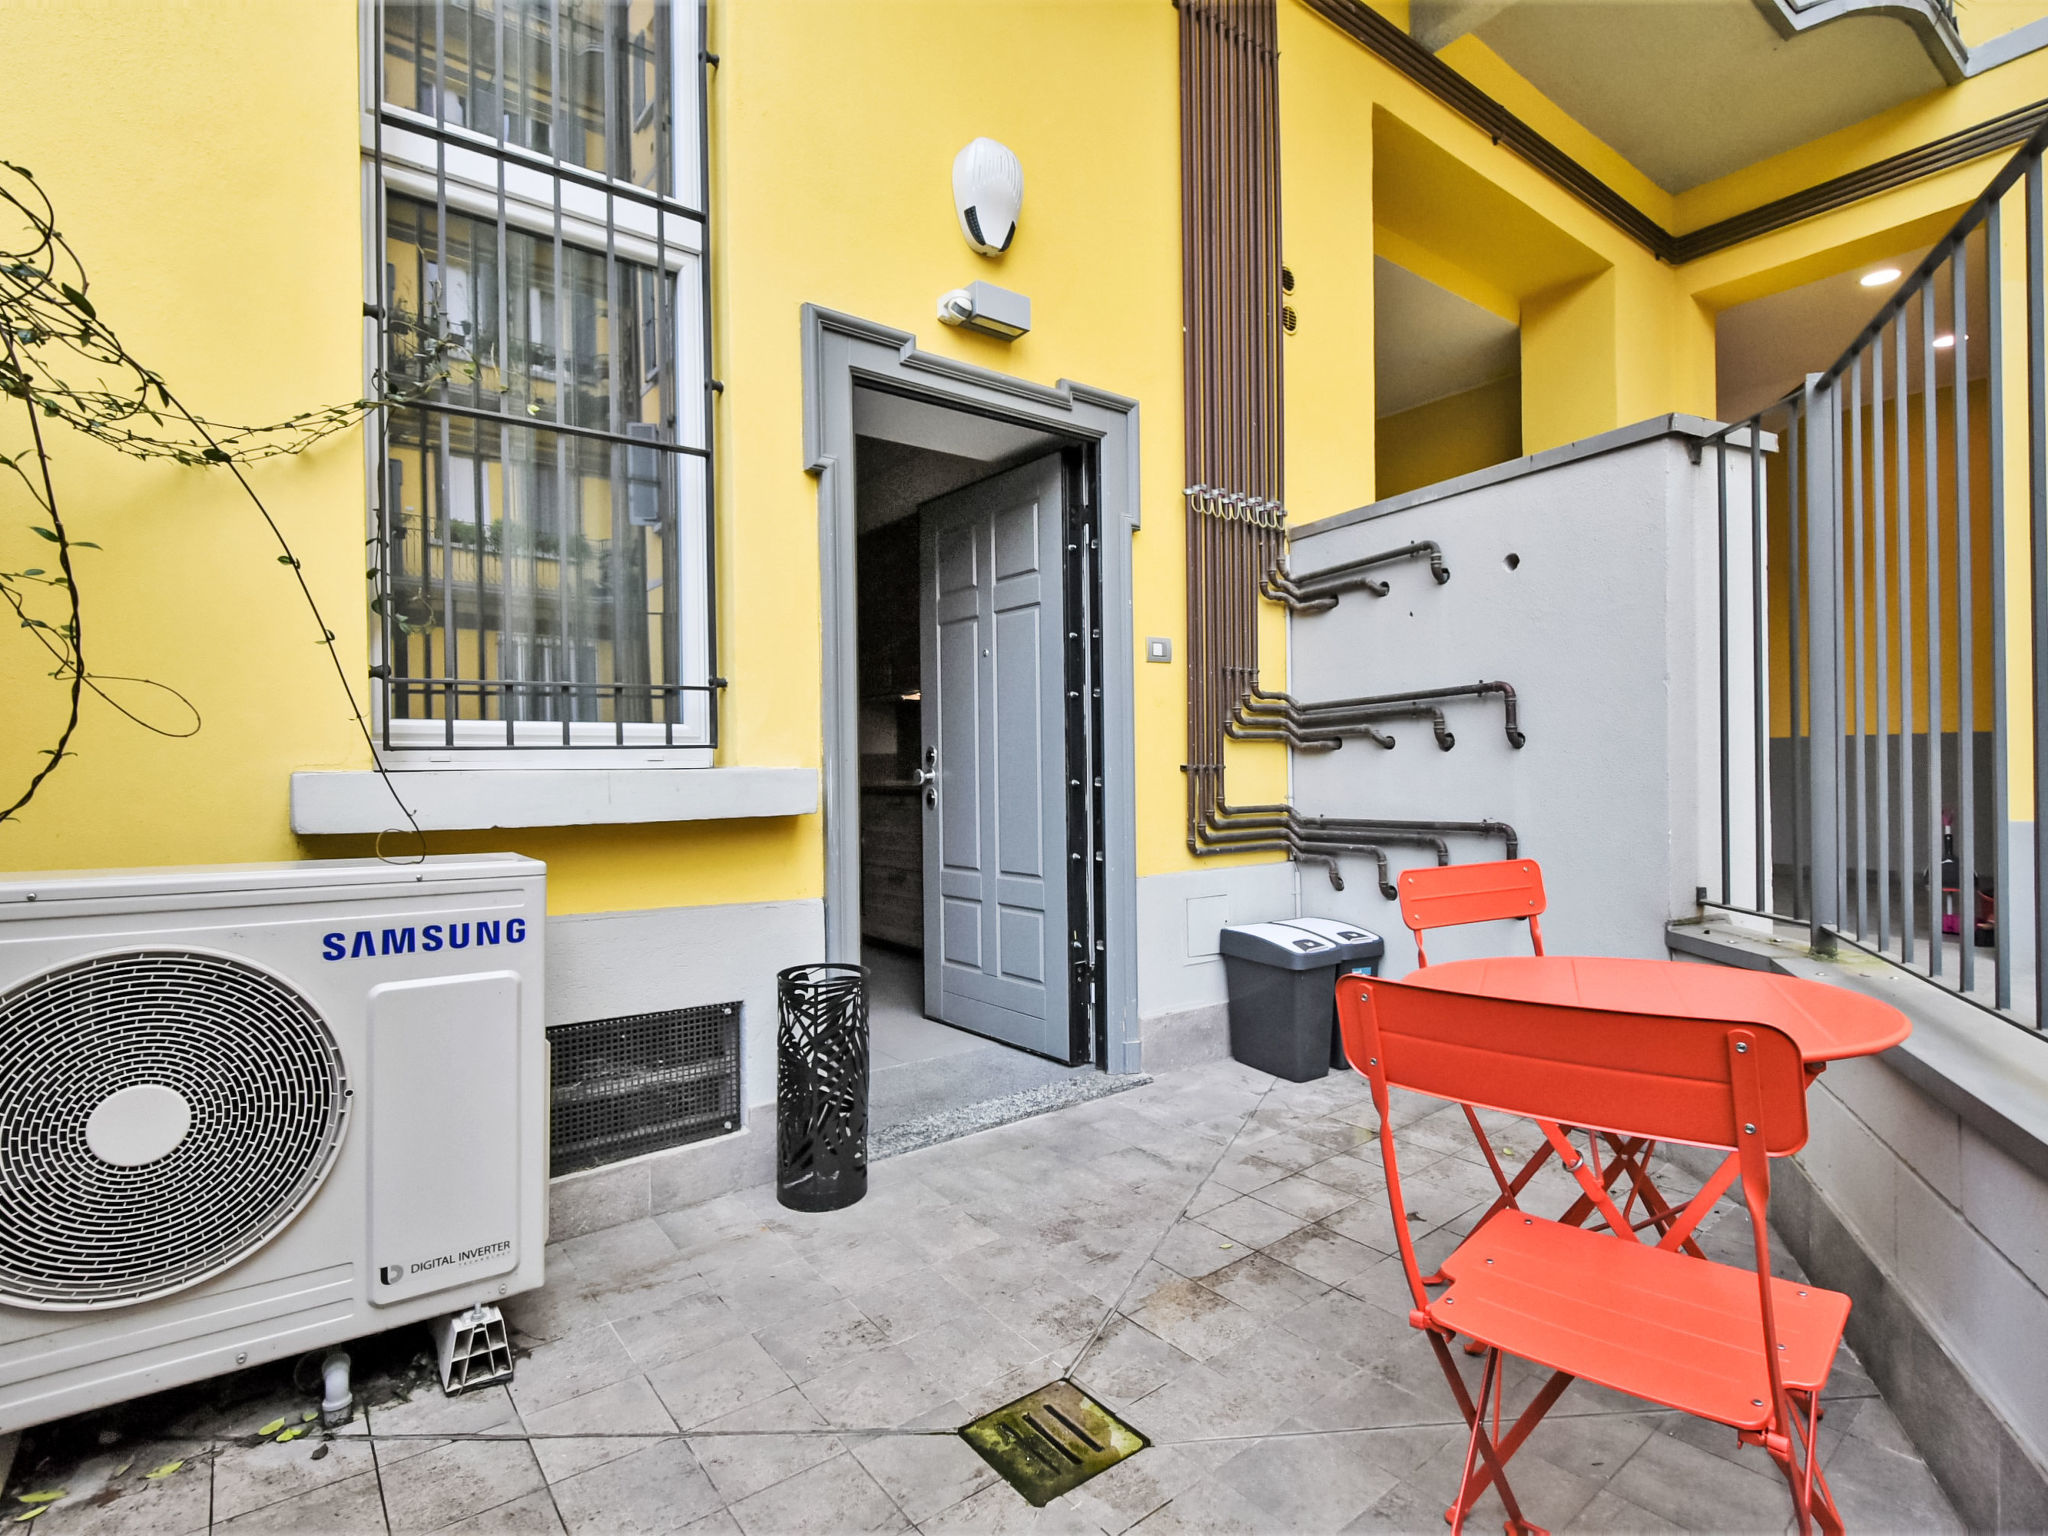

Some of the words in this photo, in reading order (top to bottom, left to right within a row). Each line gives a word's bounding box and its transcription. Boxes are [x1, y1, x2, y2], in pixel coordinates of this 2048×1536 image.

[322, 918, 526, 961] SAMSUNG
[410, 1254, 456, 1274] DIGITAL
[458, 1240, 511, 1262] INVERTER
